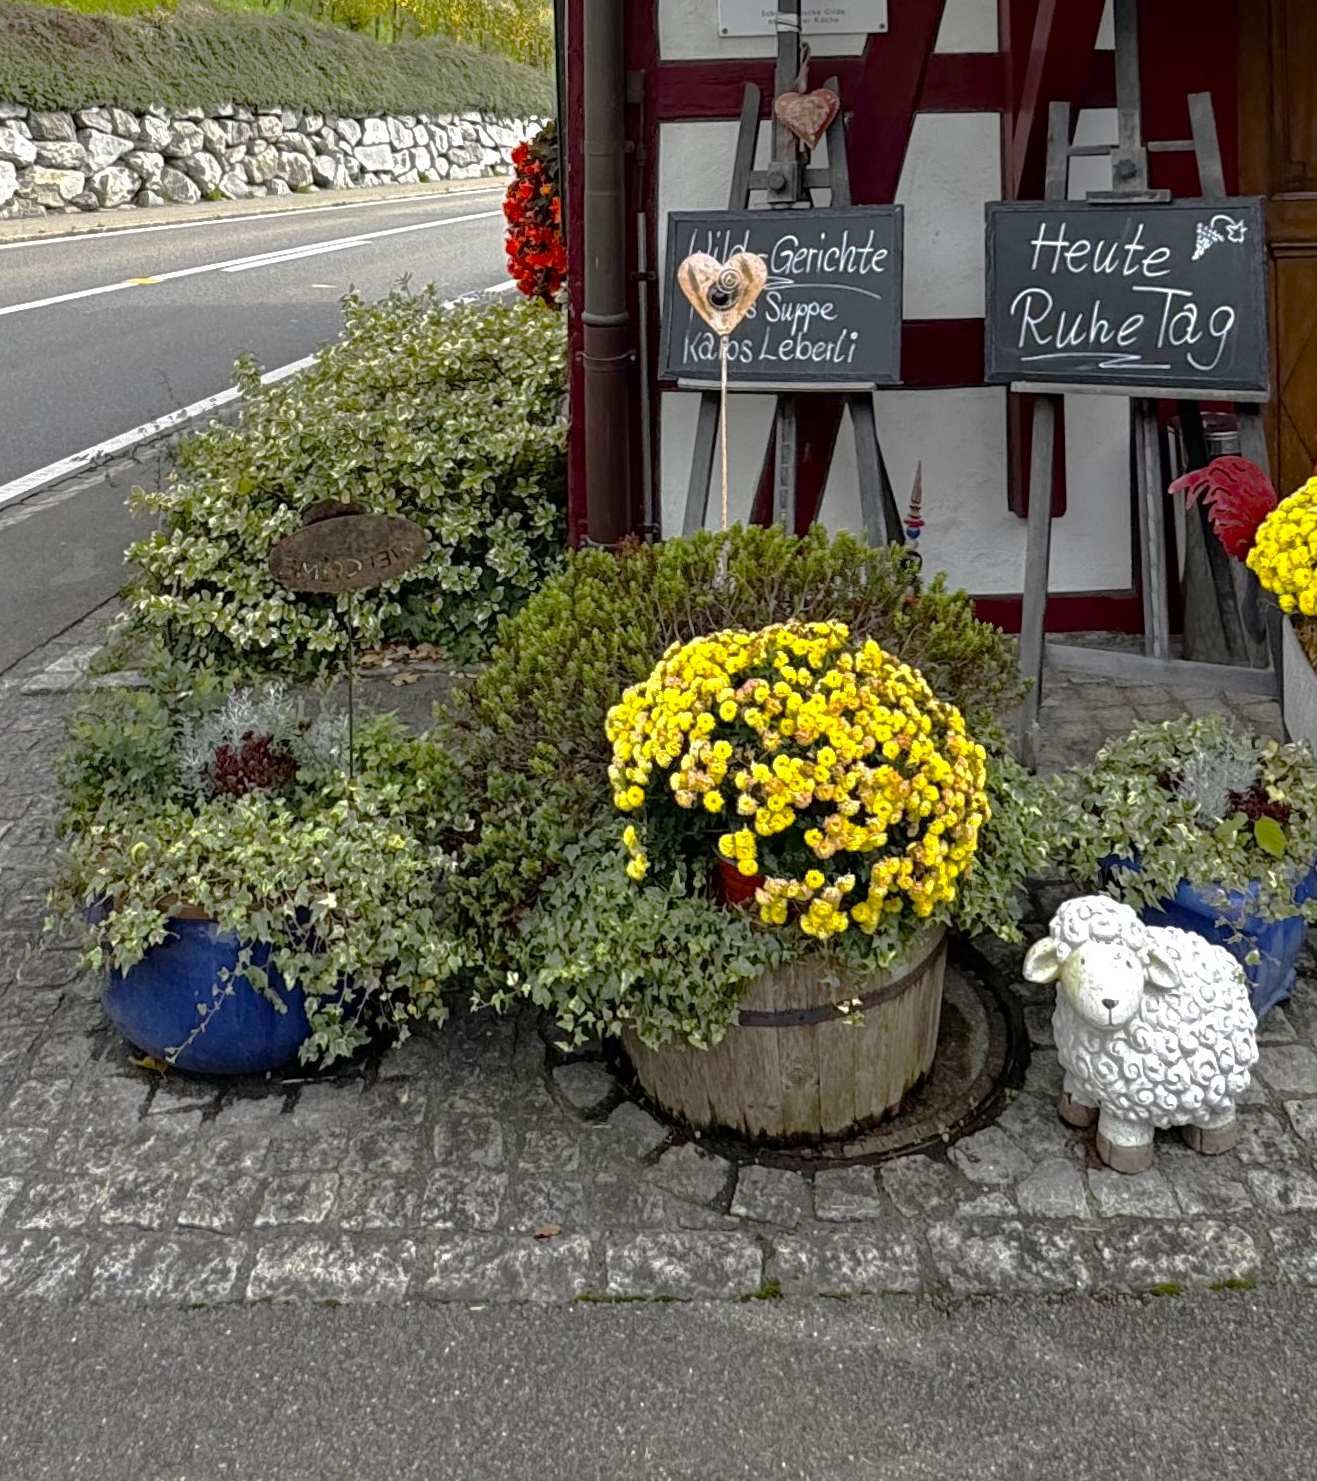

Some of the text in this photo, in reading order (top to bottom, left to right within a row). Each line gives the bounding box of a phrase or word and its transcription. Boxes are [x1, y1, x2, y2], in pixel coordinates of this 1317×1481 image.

[1030, 221, 1172, 278] Heute
[765, 290, 839, 336] Suppe
[683, 325, 859, 364] Kabs Leberli
